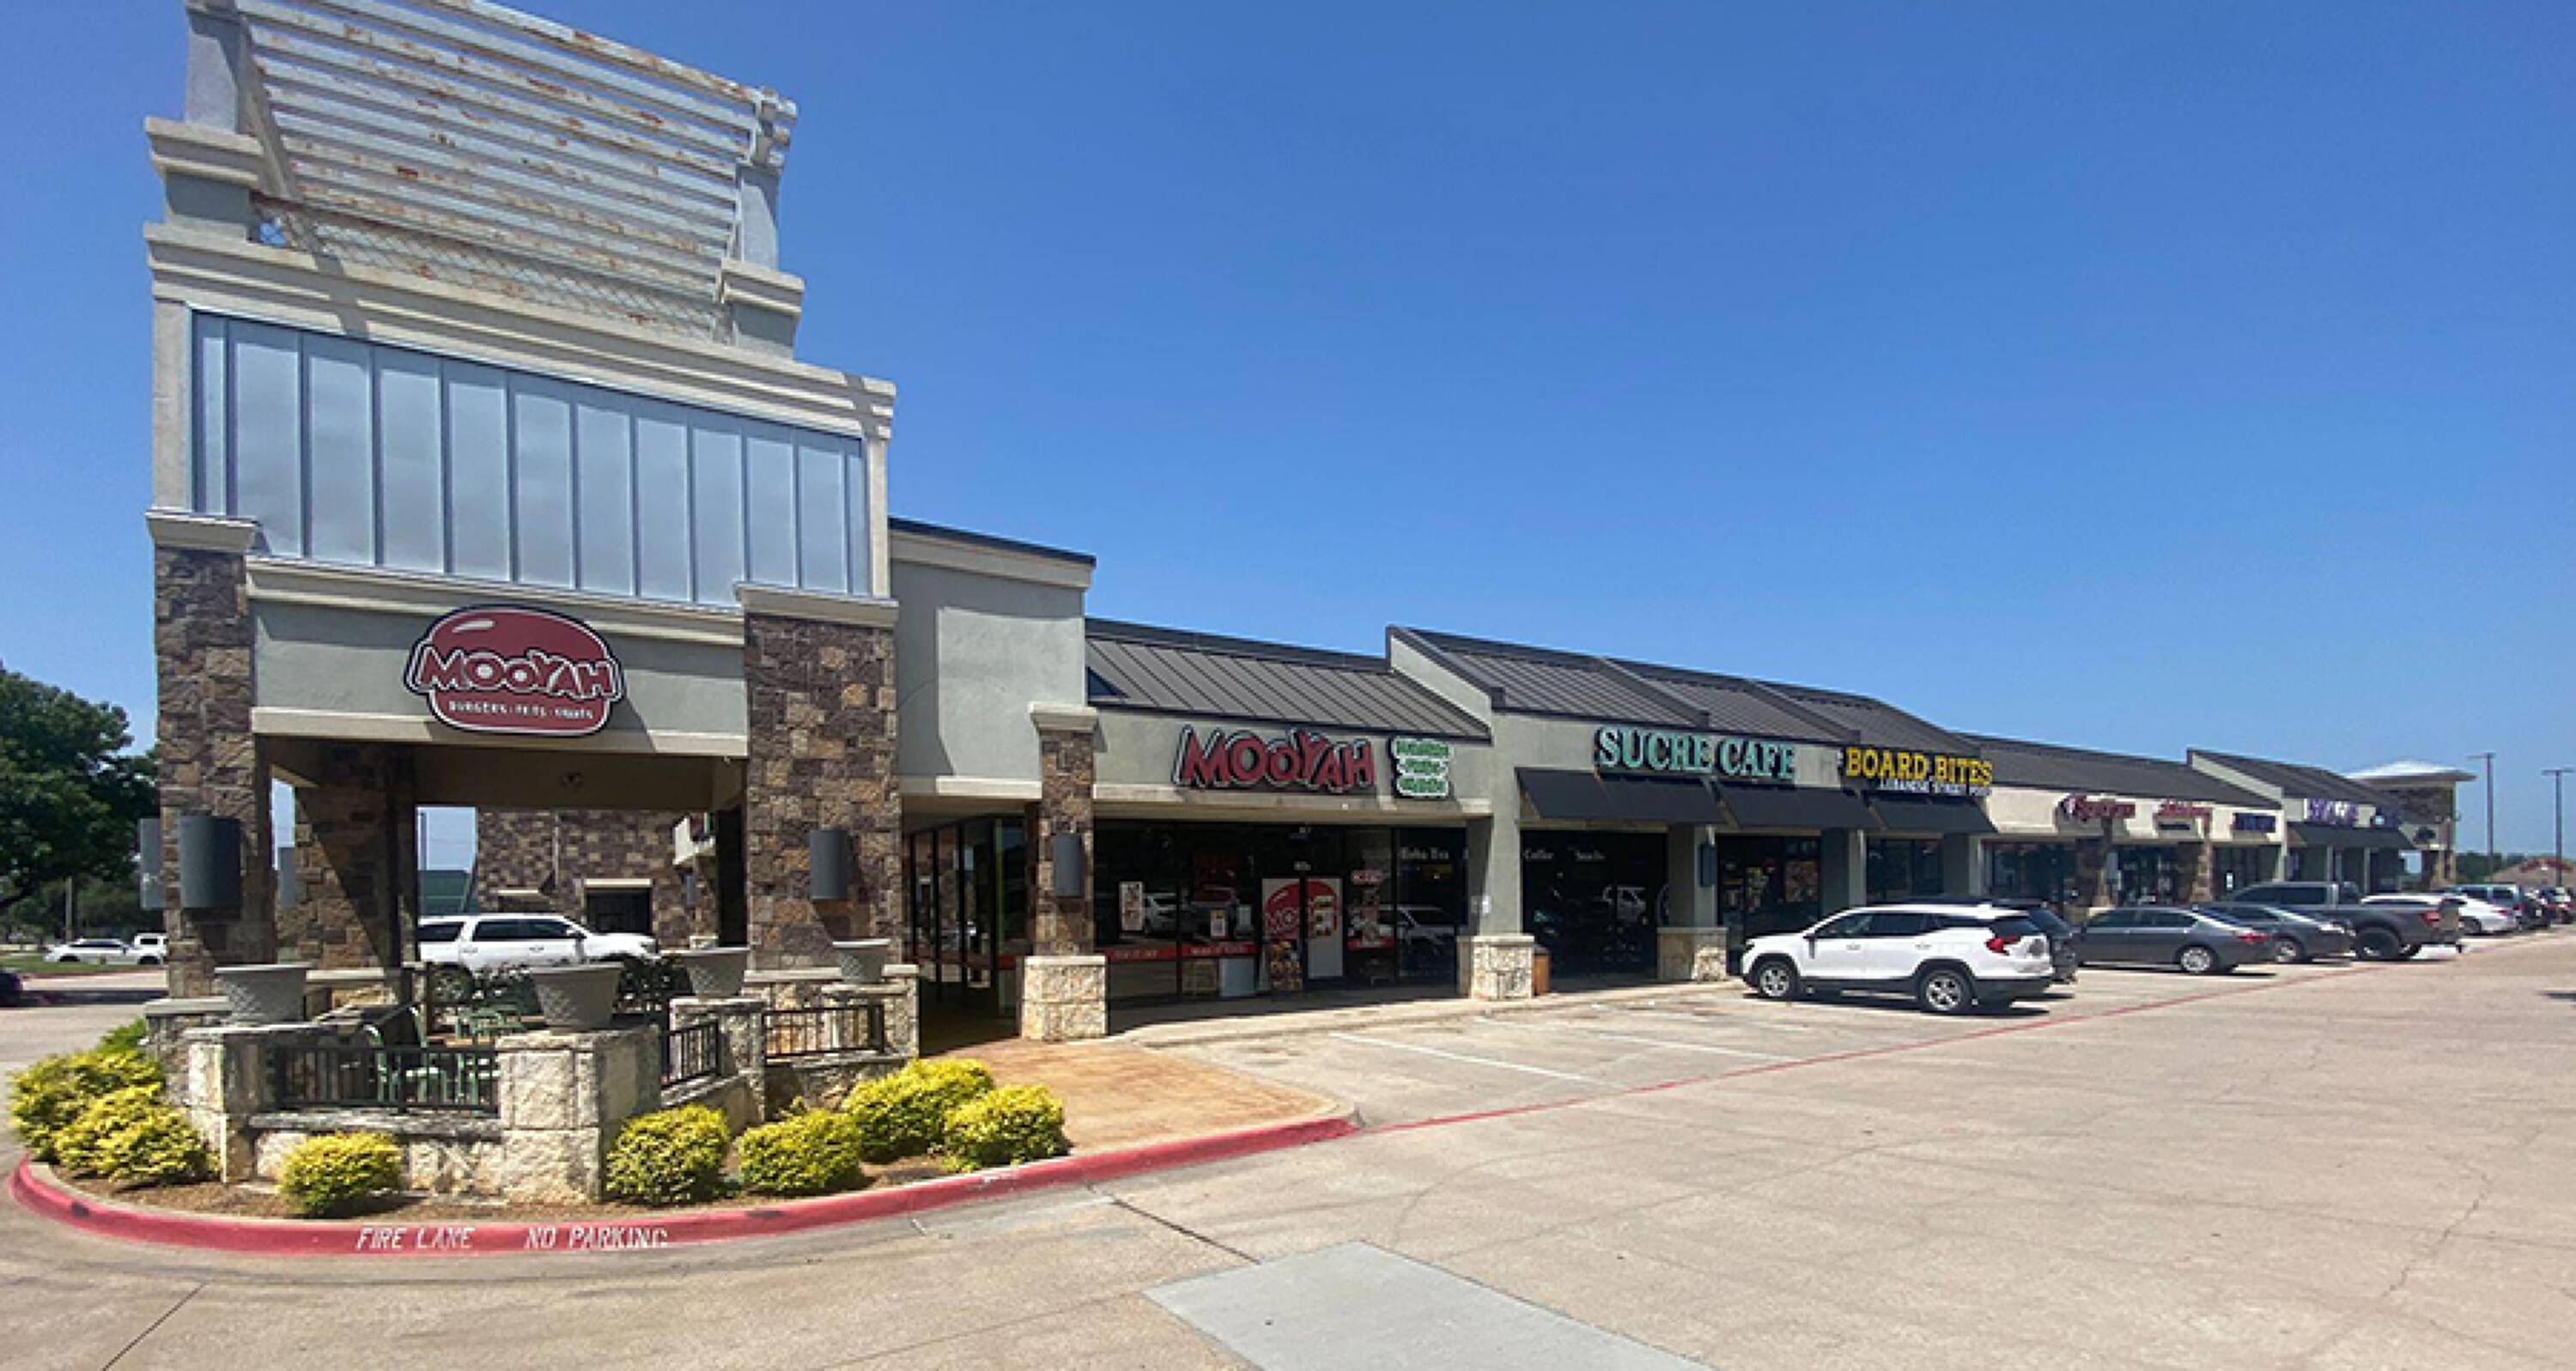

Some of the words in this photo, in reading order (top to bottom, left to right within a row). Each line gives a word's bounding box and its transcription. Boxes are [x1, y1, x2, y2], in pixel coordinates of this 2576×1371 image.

[418, 645, 615, 701] MOOYAH
[1174, 725, 1376, 792] MOOYAH
[1720, 737, 1795, 779] CAFE
[1845, 746, 1927, 780] BOARD
[1935, 755, 1993, 786] BITES
[356, 1228, 408, 1250] FIRE
[416, 1228, 476, 1250] LANE
[525, 1227, 556, 1250] NO
[568, 1226, 669, 1251] PARKING
